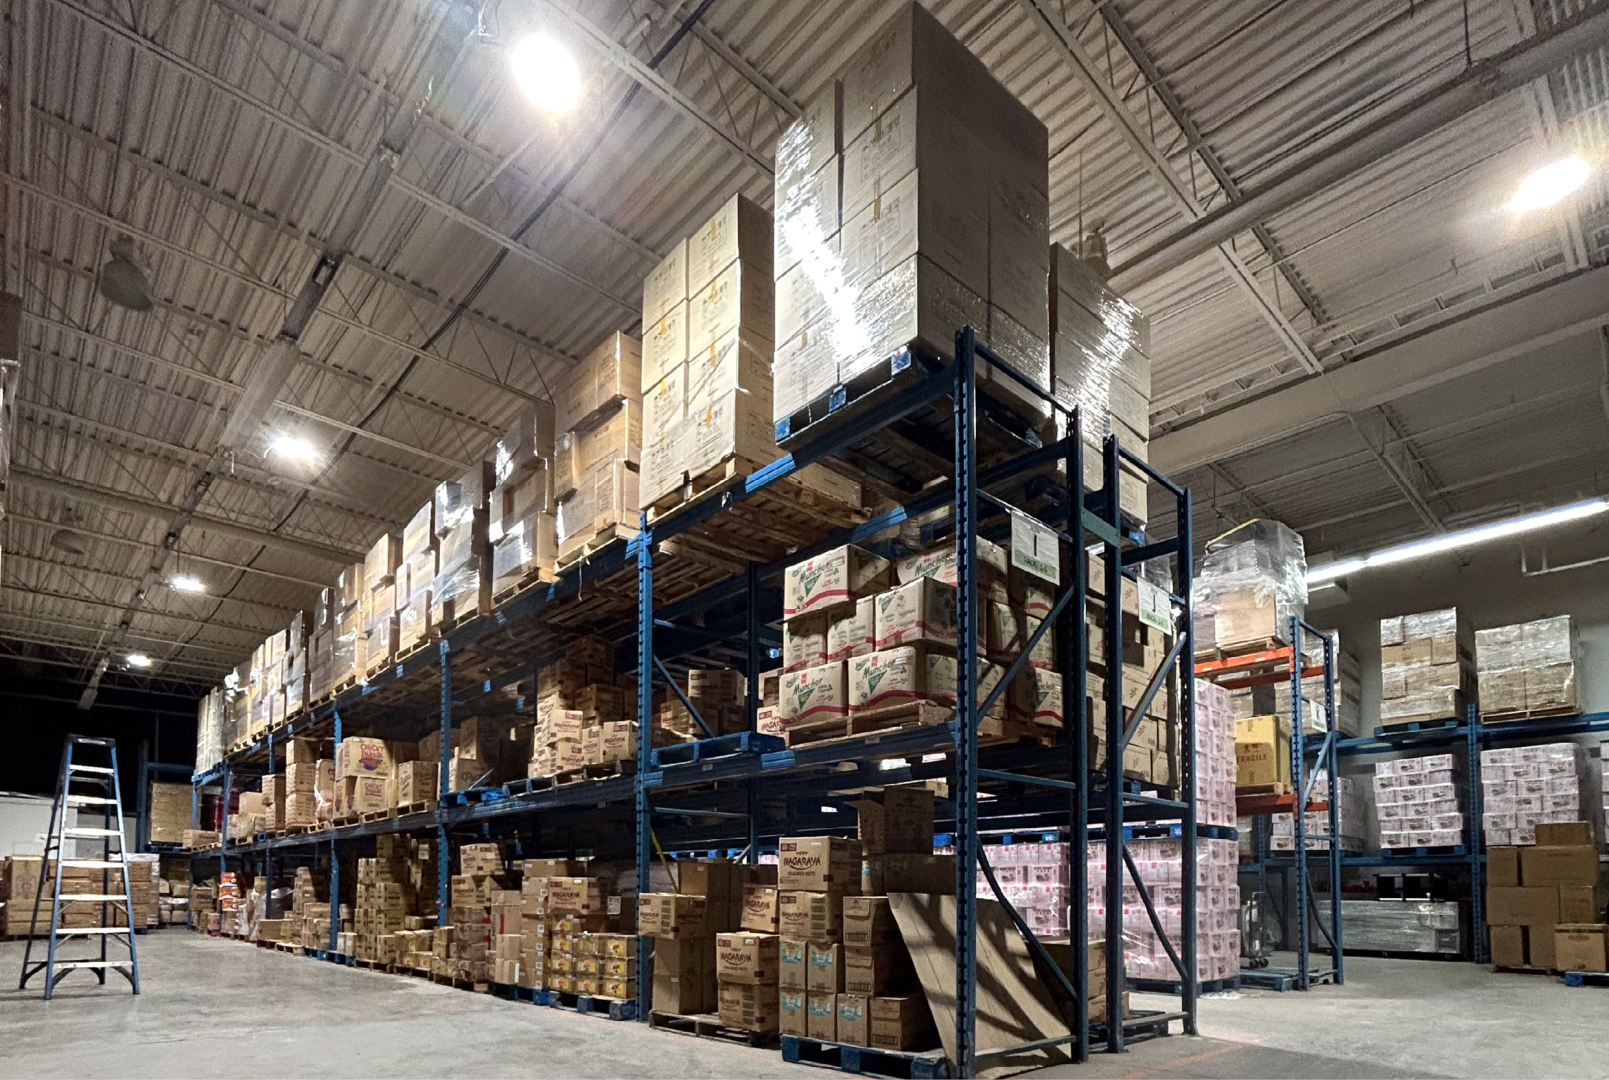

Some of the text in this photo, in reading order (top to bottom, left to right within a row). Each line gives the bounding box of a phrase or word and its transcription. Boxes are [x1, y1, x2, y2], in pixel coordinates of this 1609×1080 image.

[799, 560, 830, 585] Muncher
[862, 658, 897, 680] Muncher
[792, 677, 825, 697] Muncher
[1236, 754, 1268, 763] FRAGILE
[783, 855, 821, 867] NAGARAYA
[720, 952, 752, 963] NAGARAYA
